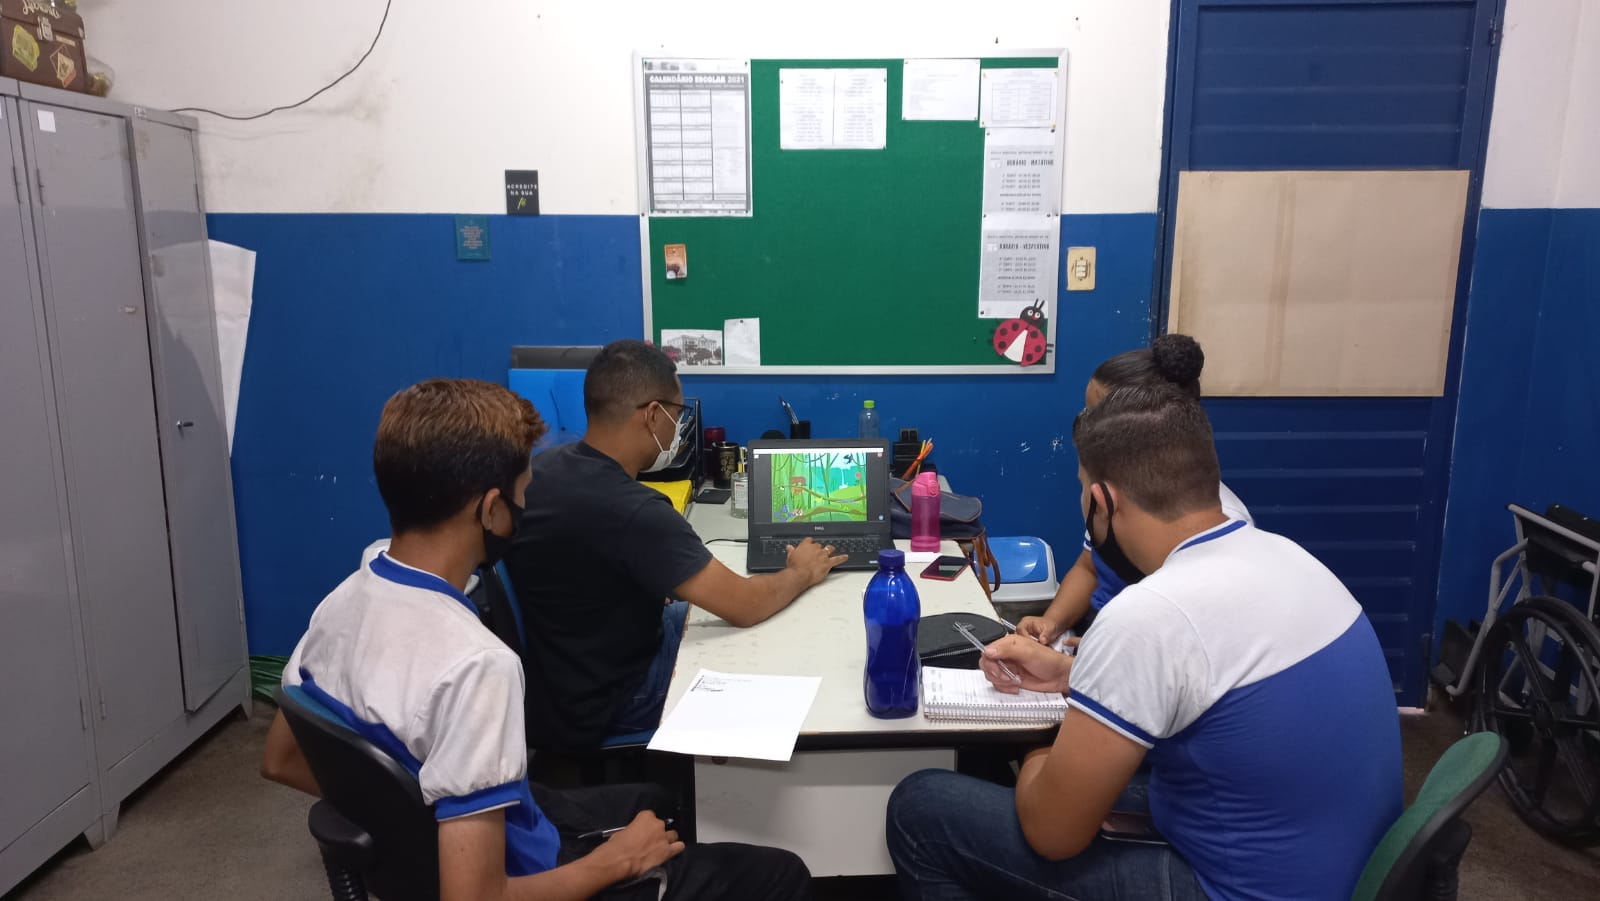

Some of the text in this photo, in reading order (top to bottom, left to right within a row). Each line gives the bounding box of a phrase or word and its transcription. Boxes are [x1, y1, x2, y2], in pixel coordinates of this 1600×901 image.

[649, 74, 745, 83] CALENDÁRIO ESCOLAR 2021
